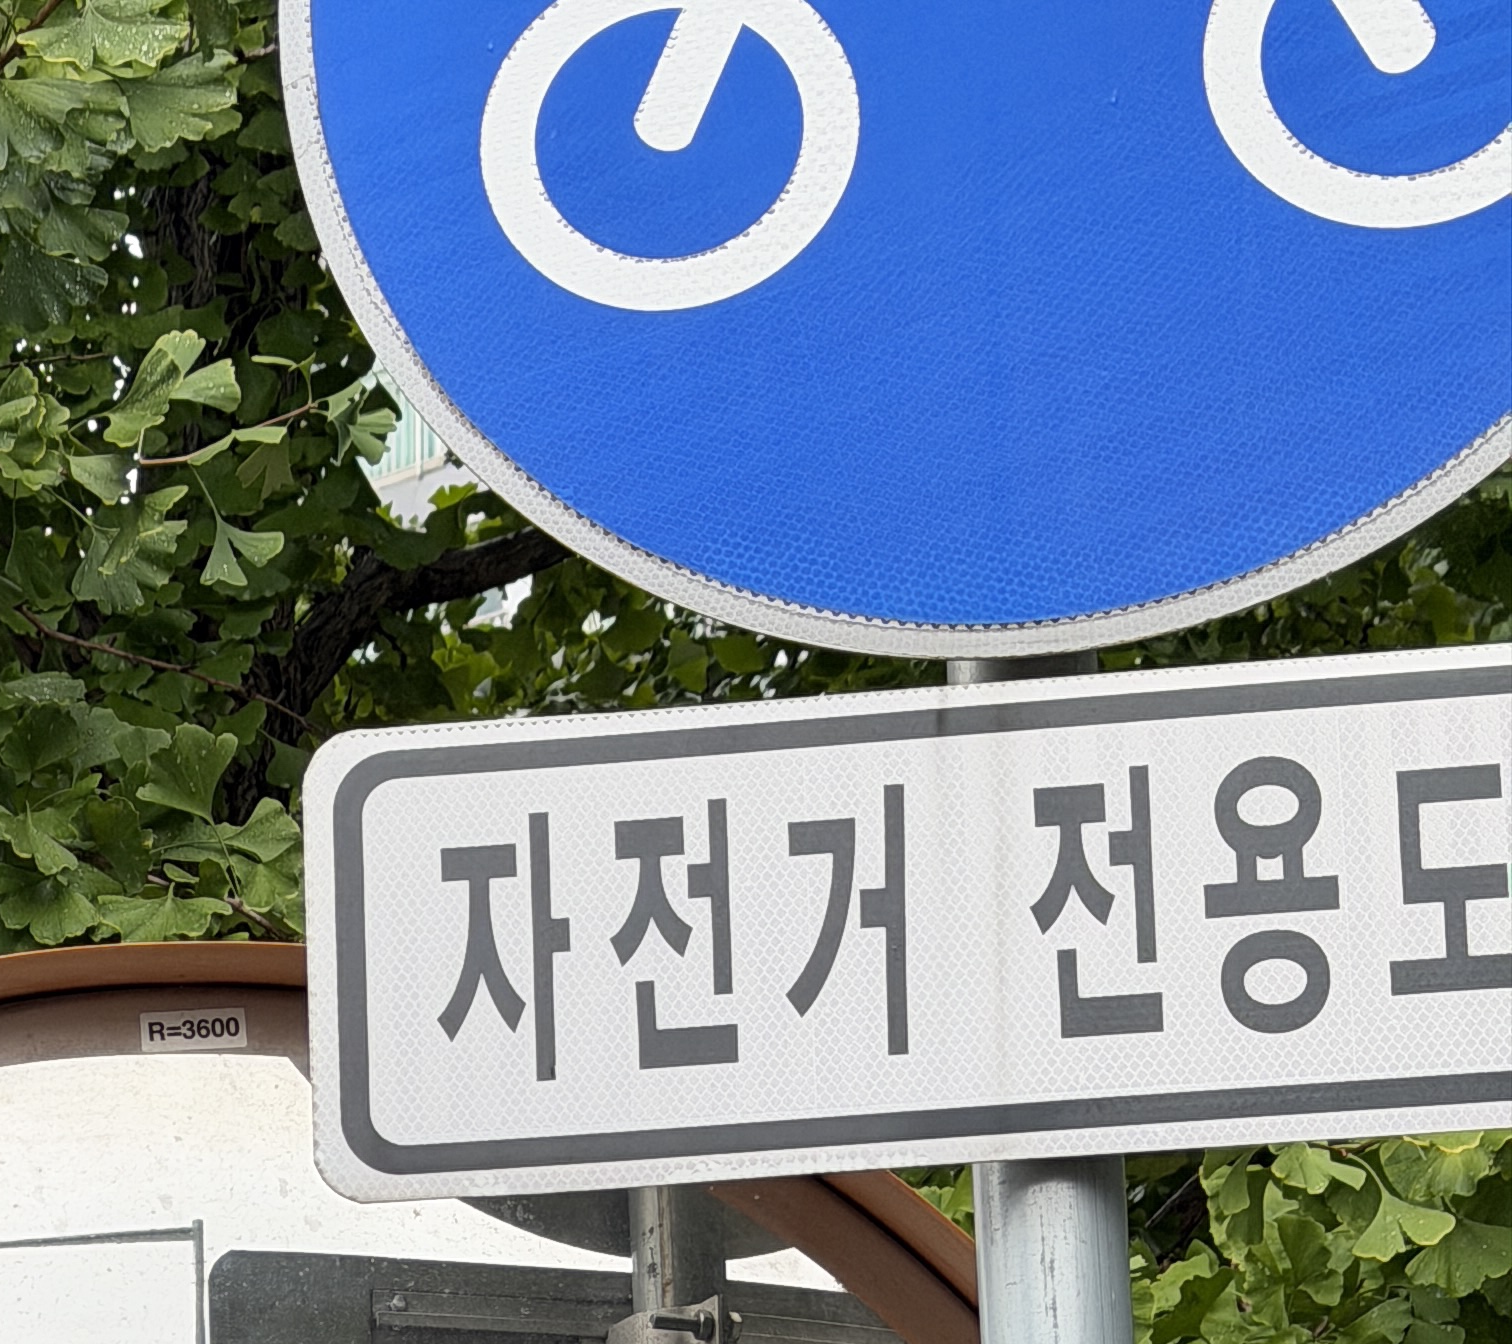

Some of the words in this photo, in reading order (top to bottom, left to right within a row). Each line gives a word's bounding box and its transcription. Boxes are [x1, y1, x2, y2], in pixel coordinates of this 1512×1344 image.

[437, 784, 909, 1082] 자전거
[1030, 755, 1512, 1040] 전용도
[148, 1017, 240, 1042] R=3600
